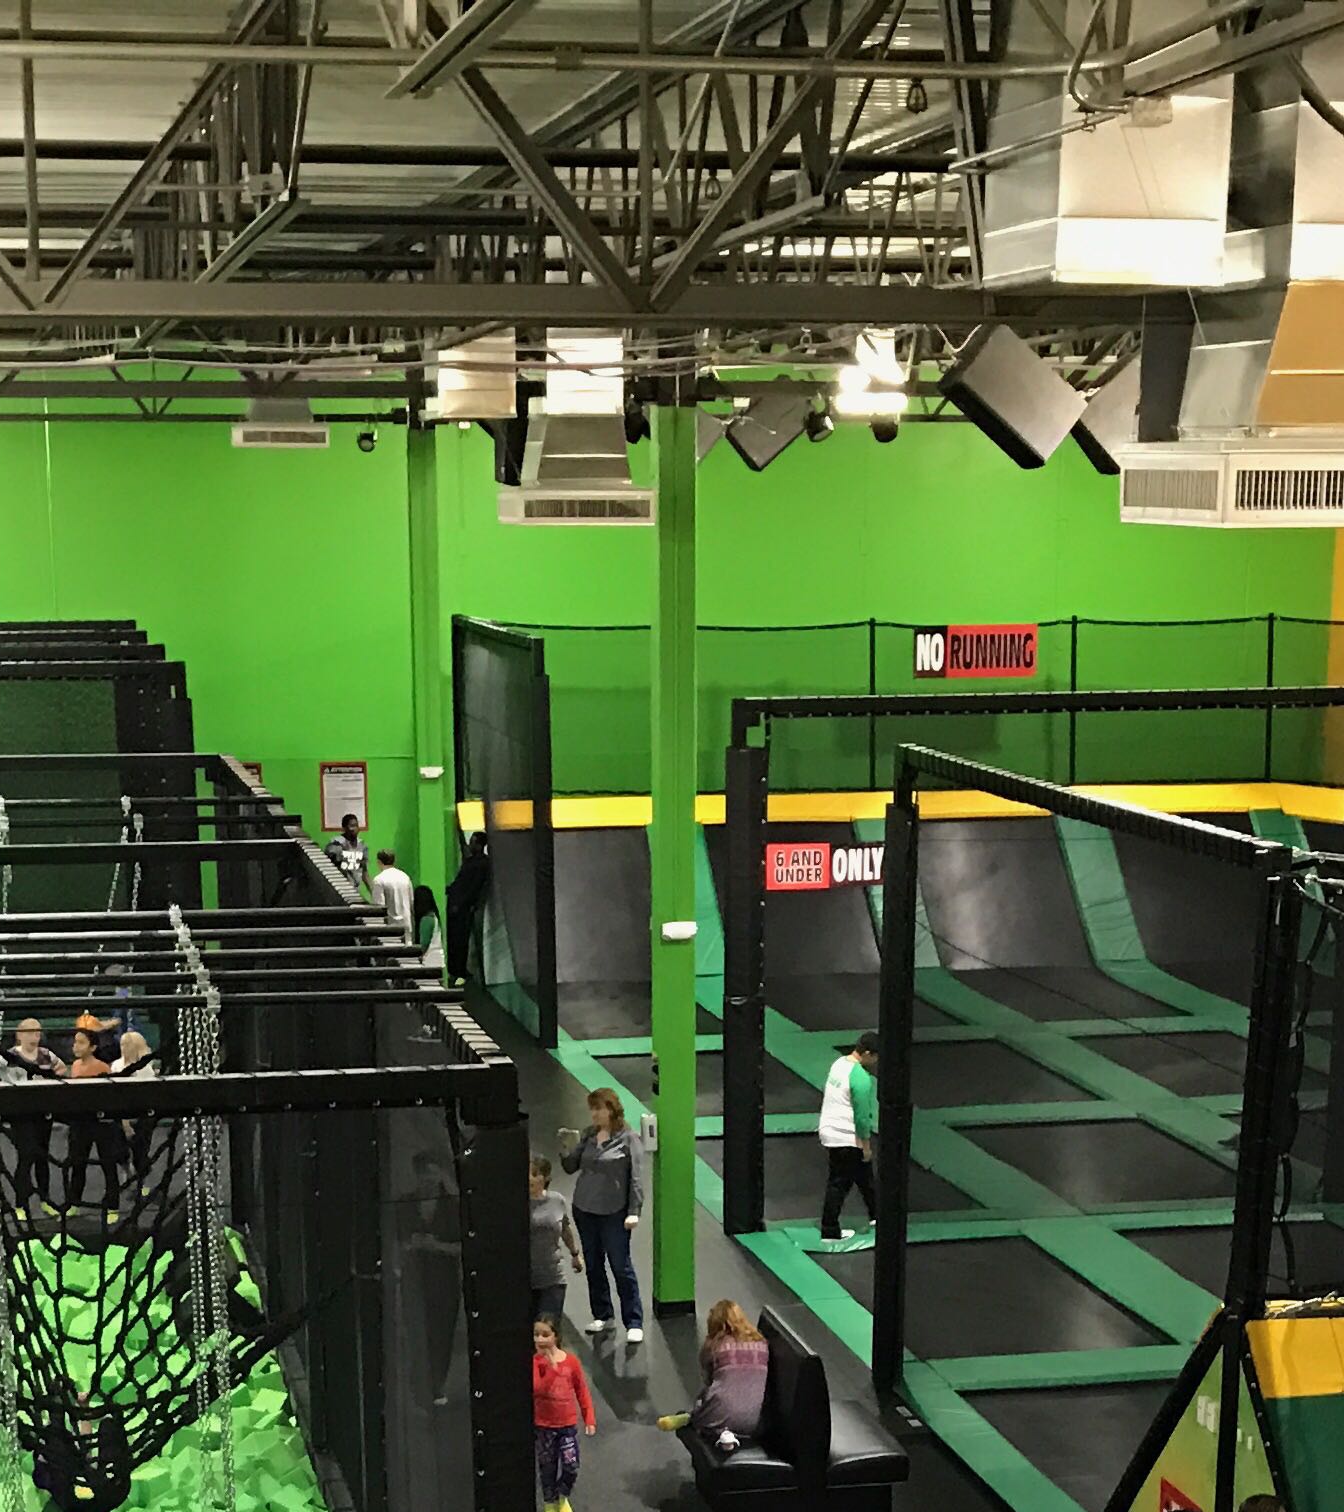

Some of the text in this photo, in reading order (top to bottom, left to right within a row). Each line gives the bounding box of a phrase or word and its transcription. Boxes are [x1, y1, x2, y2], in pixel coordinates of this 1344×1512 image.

[916, 633, 1034, 672] NO RUNNING
[775, 850, 823, 868] 6 AND
[832, 846, 885, 883] ONLY
[775, 868, 823, 883] UNDER
